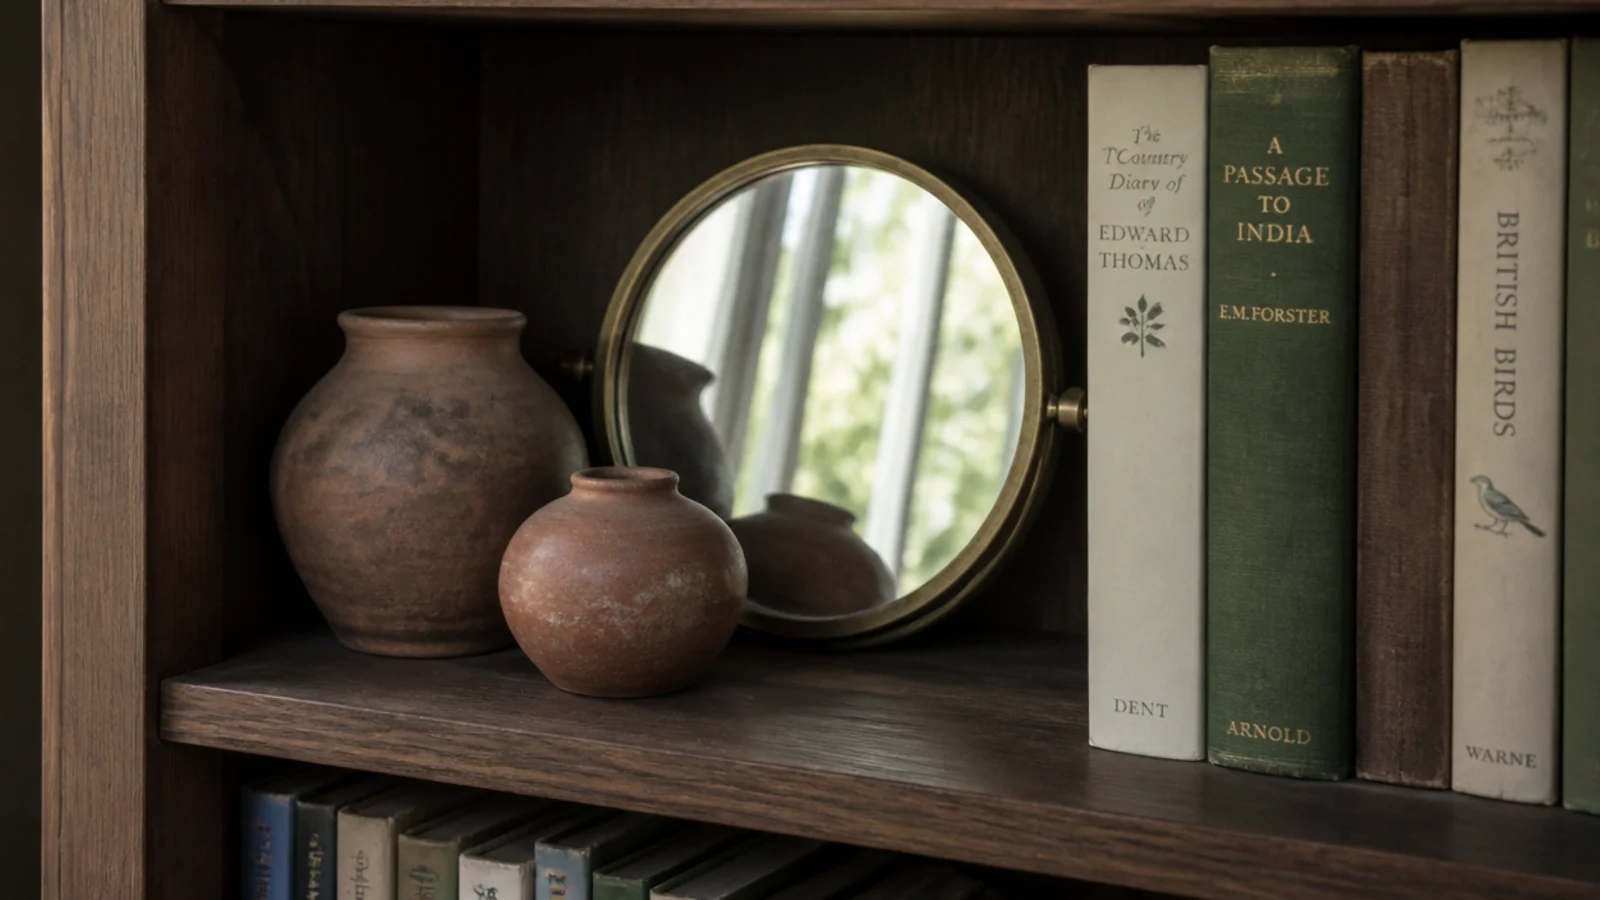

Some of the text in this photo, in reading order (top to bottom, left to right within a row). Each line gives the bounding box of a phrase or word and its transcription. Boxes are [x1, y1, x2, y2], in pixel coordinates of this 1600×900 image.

[1267, 136, 1283, 154] A
[1165, 174, 1187, 194] of
[1223, 164, 1330, 187] PASSAGE
[1257, 195, 1291, 214] TO
[1099, 225, 1190, 243] EDWARD
[1236, 222, 1313, 243] INDIA
[1099, 252, 1190, 271] THOMAS
[1492, 211, 1520, 437] BRITISH BIRDS
[1113, 698, 1169, 719] DENT
[1226, 720, 1312, 746] ARNOLD
[1466, 744, 1538, 769] WARNE
